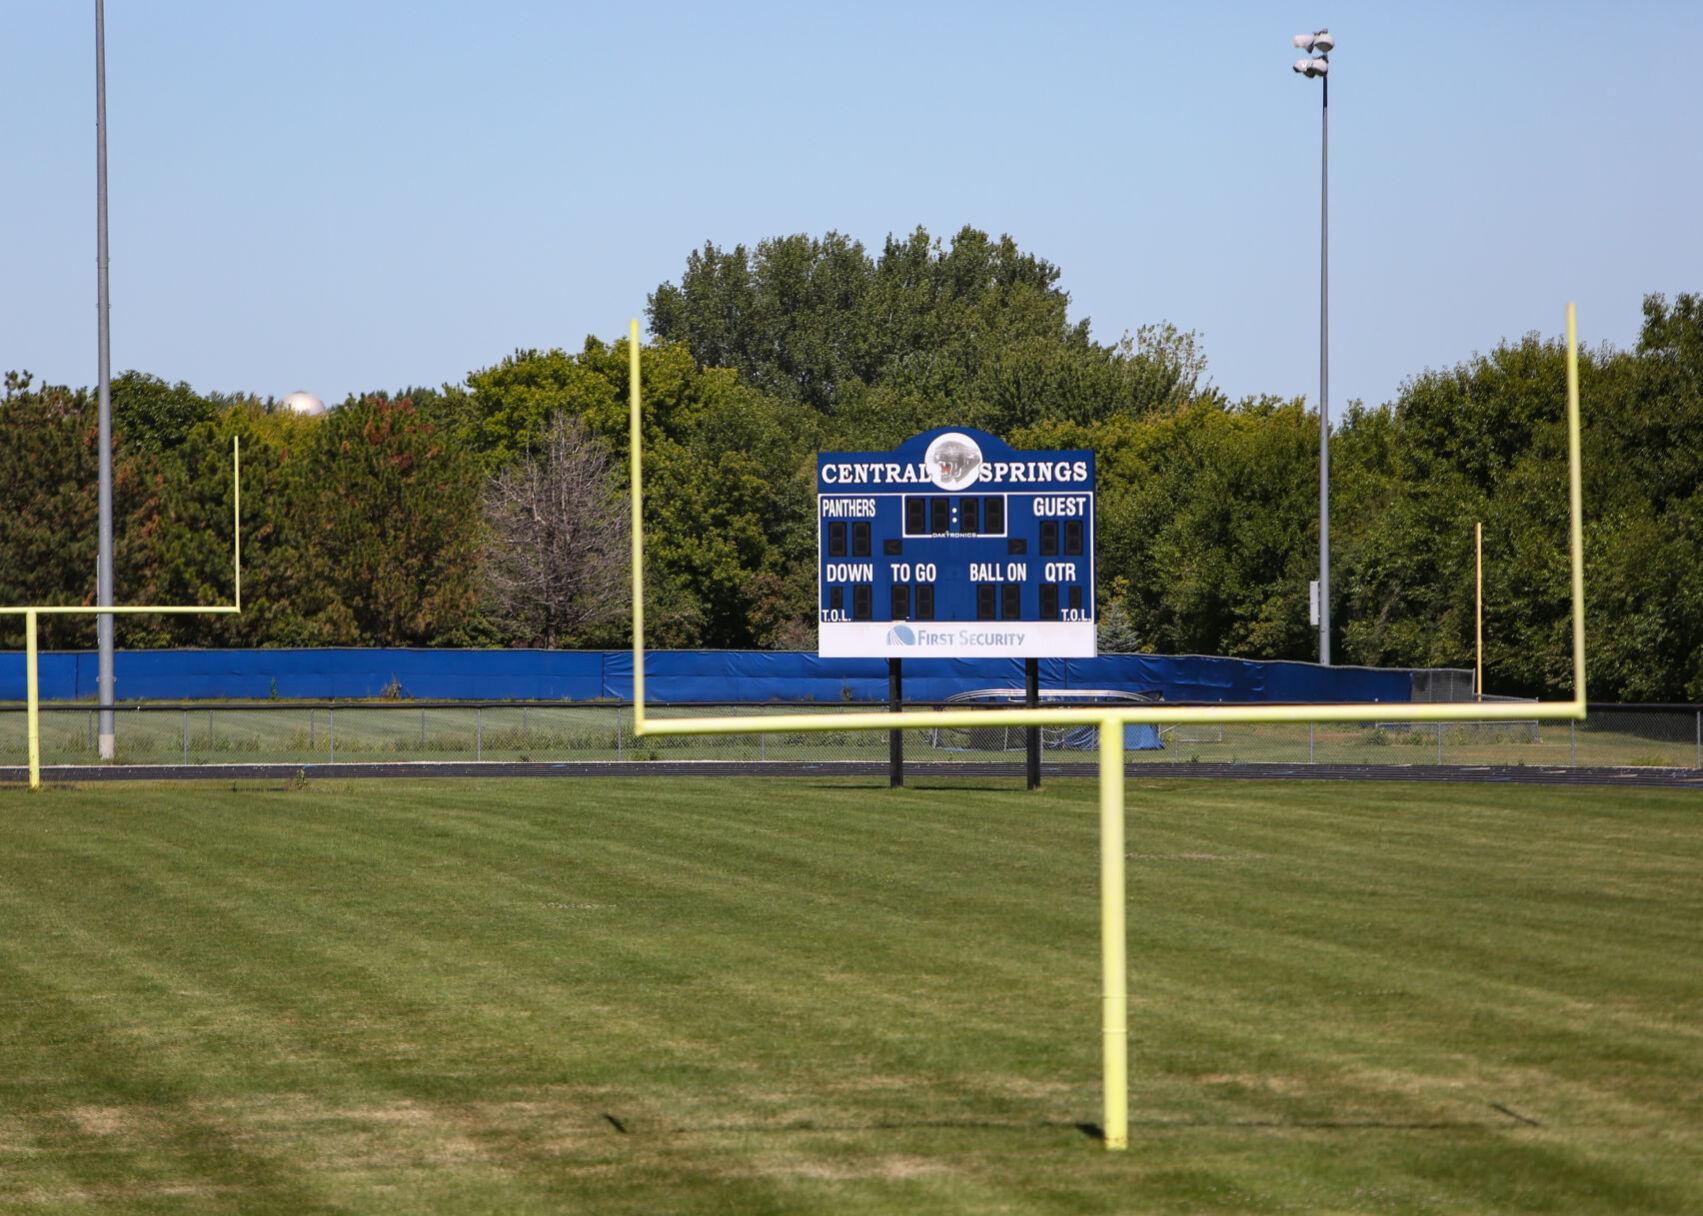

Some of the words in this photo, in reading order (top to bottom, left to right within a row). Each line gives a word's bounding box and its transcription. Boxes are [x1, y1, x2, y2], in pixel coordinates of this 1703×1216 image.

[821, 463, 932, 484] CENTRAL
[979, 461, 1088, 482] SPRINGS
[822, 498, 876, 517] PANTHERS
[1033, 497, 1086, 516] GUEST
[826, 563, 873, 582] DOWN
[890, 563, 910, 582] TO
[915, 563, 937, 582] GO
[969, 563, 1004, 582] BALL
[1007, 563, 1027, 582] ON
[1044, 562, 1076, 583] QTR
[822, 609, 851, 622] T.O.L.
[1061, 608, 1091, 622] T.O.L.
[918, 630, 954, 646] FIRST
[959, 630, 1025, 646] SECURITY
